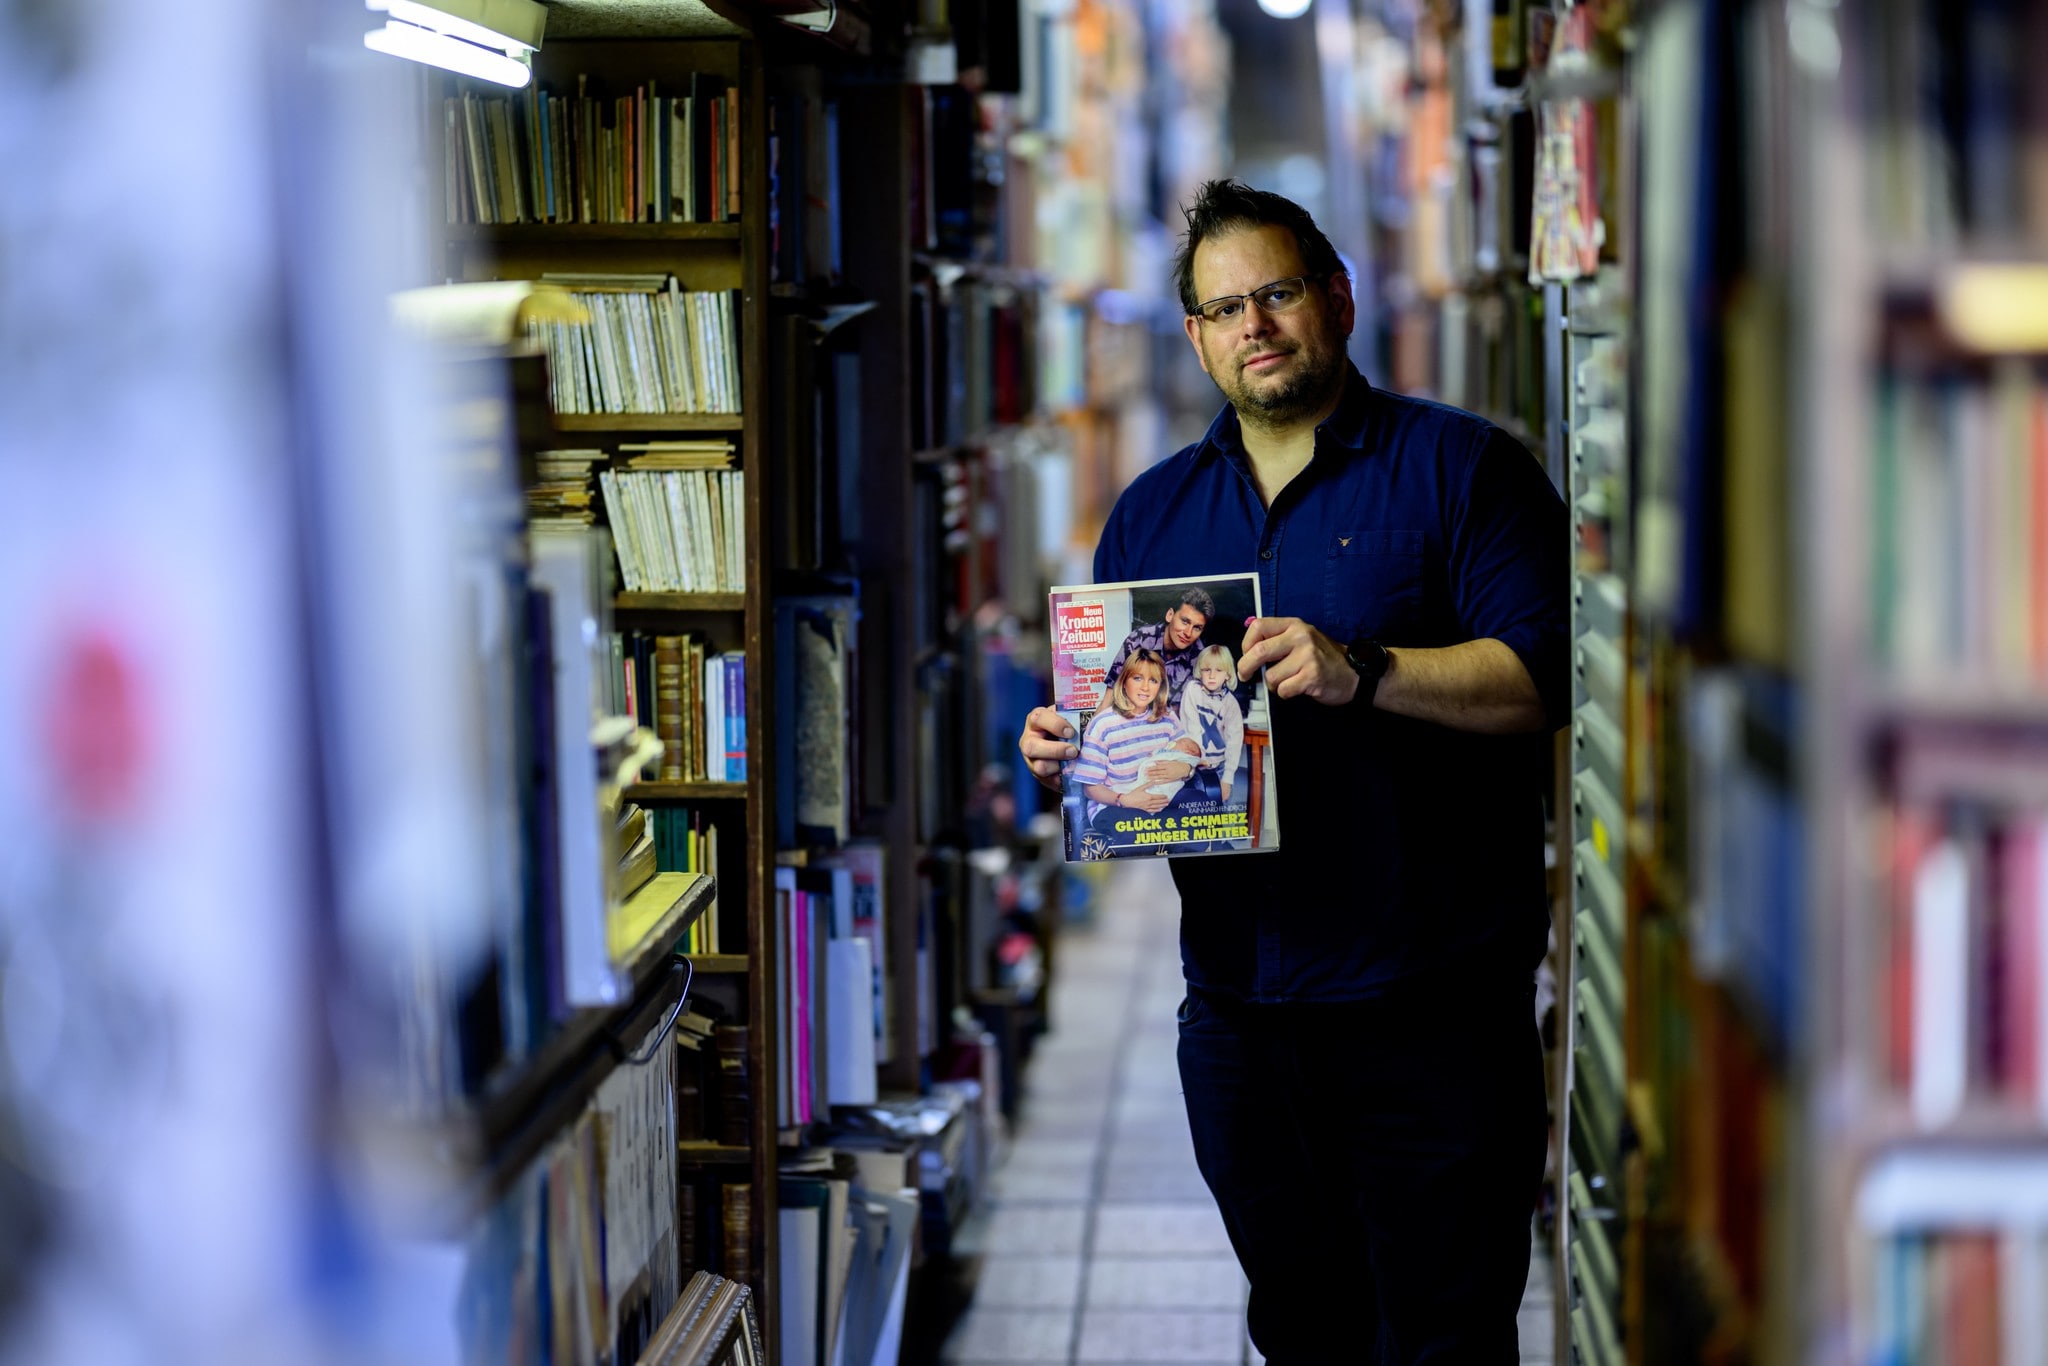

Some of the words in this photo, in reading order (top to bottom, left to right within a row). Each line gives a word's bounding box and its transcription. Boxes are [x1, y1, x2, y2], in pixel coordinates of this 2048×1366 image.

[1083, 607, 1102, 616] Neue
[1060, 615, 1103, 630] Kronen
[1060, 629, 1104, 645] Zeitung
[1178, 801, 1202, 809] ANDREA
[1188, 806, 1218, 814] RAINHARD
[1219, 803, 1247, 812] FENDRICH
[1115, 816, 1162, 832] GLÜCK
[1165, 817, 1177, 829] &
[1181, 812, 1248, 828] SCHMERZ
[1134, 830, 1189, 844] JUNGER
[1193, 825, 1249, 840] MÜTTER
